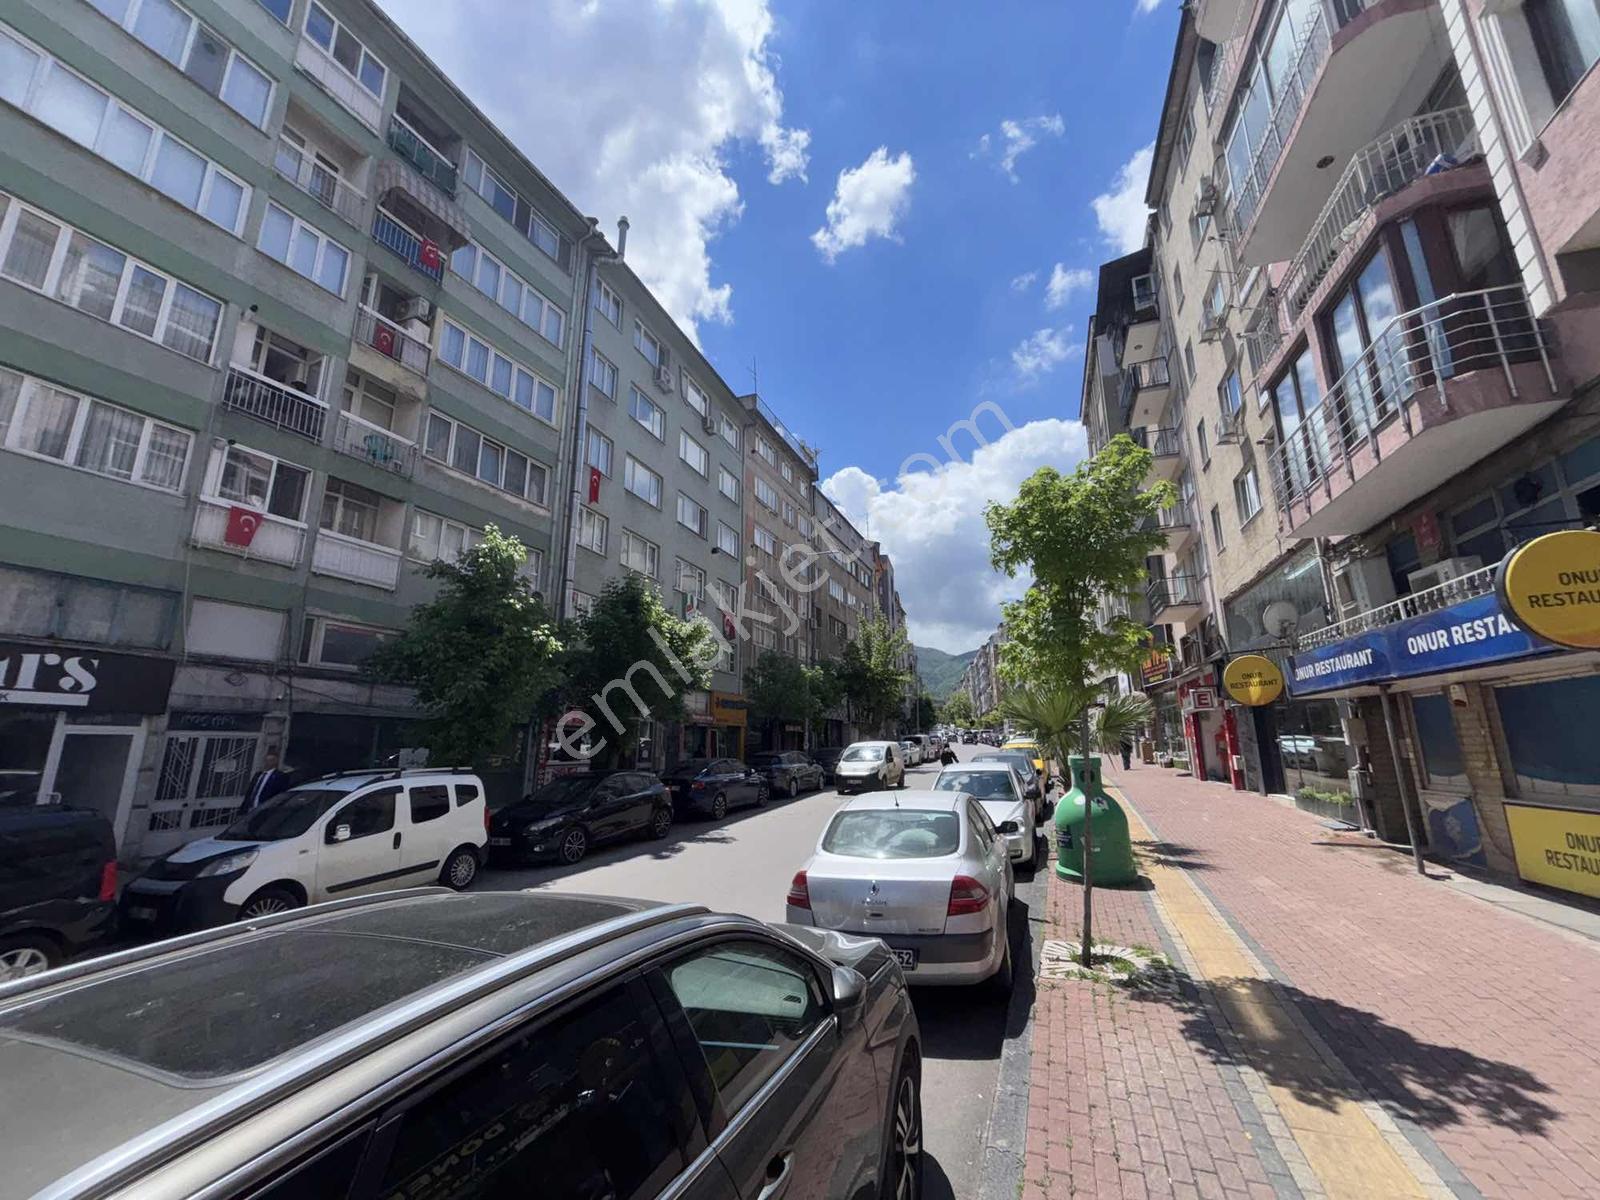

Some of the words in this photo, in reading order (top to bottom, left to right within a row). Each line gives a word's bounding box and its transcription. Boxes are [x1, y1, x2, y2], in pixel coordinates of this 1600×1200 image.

[1558, 569, 1600, 587] ONU
[1407, 629, 1450, 655] ONUR
[1295, 664, 1316, 682] ONUR
[1315, 648, 1373, 676] RESTAURANT
[1241, 671, 1263, 680] ONUR
[1230, 679, 1277, 689] RESTAURANT
[892, 951, 912, 965] 52
